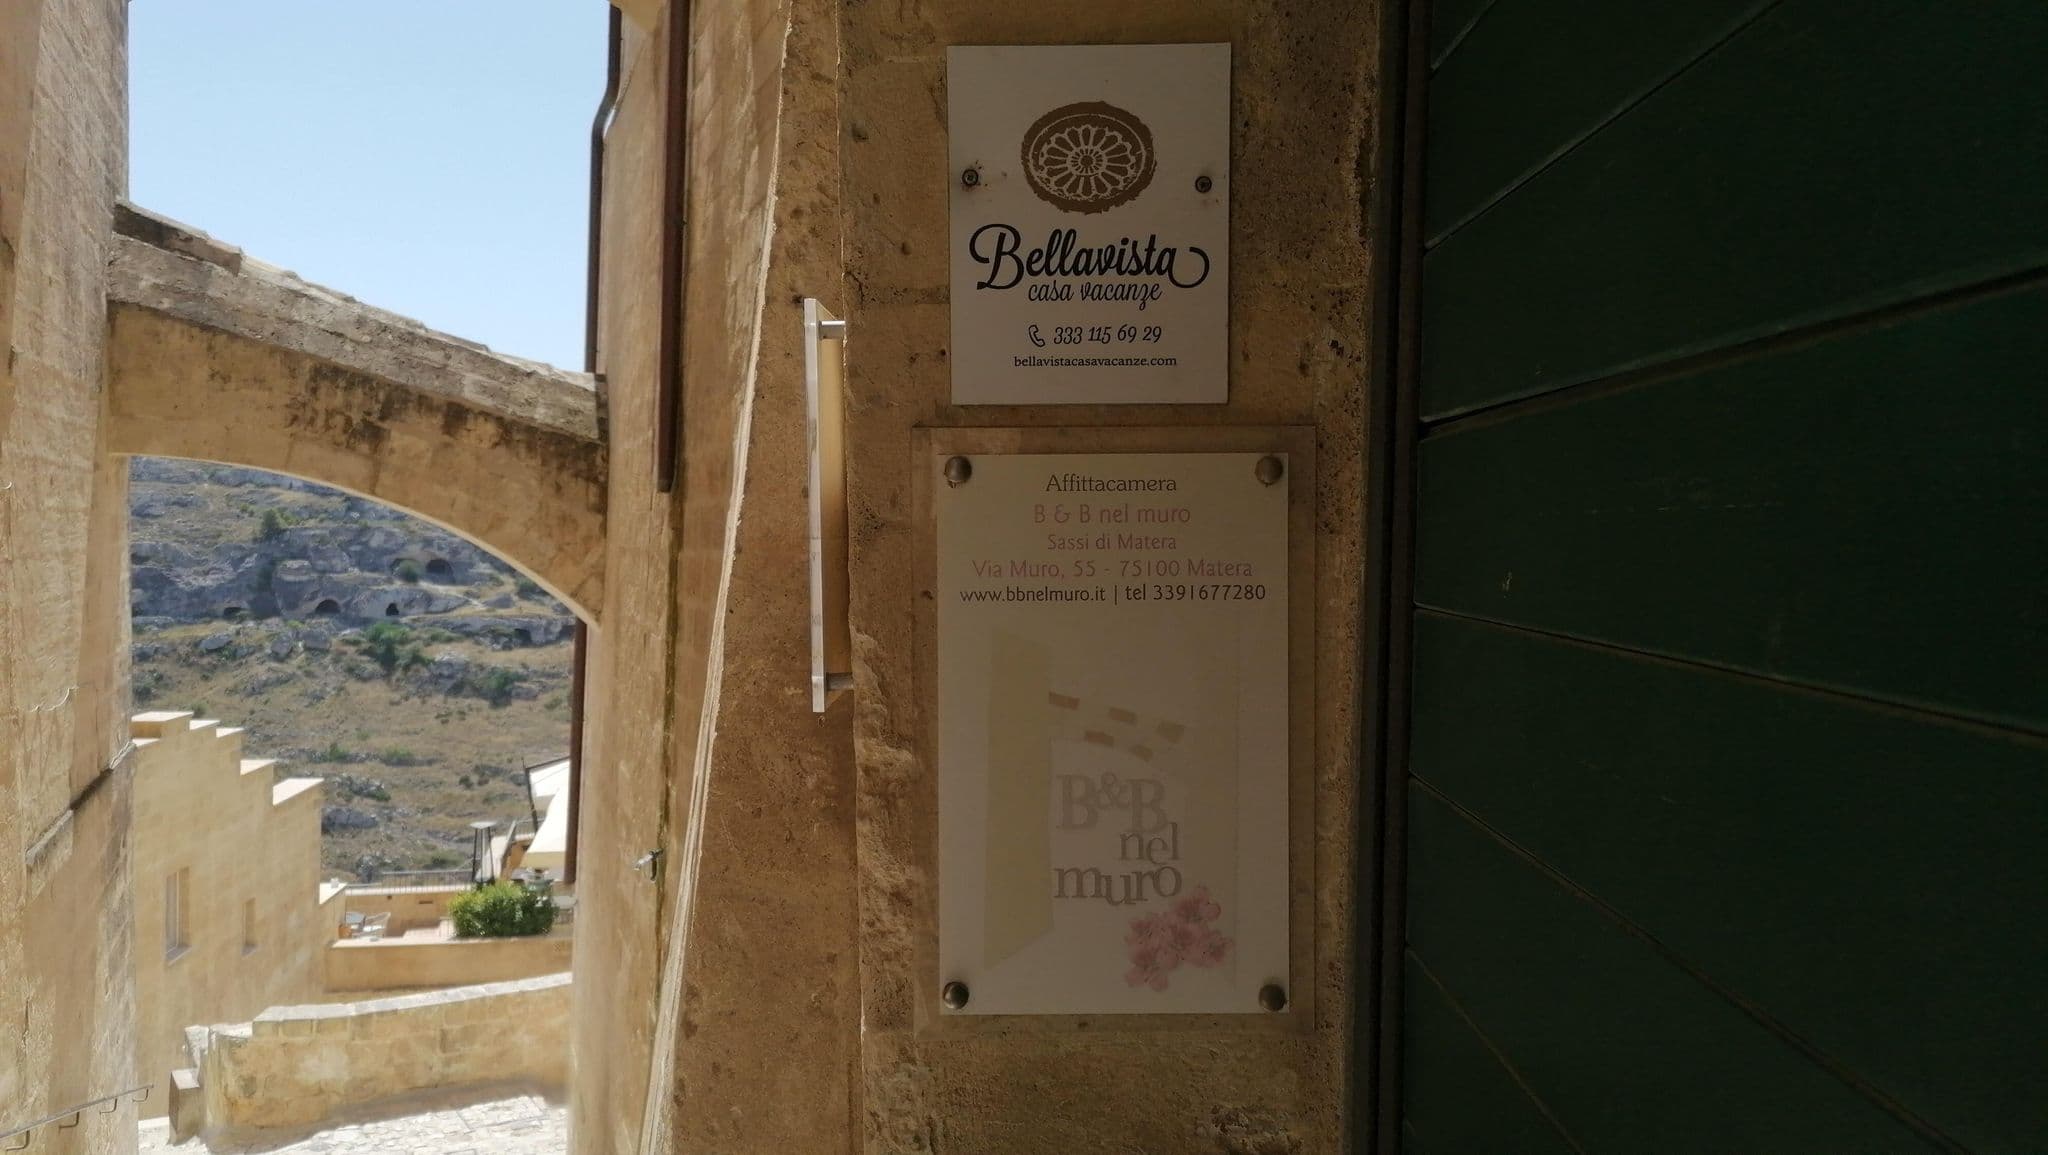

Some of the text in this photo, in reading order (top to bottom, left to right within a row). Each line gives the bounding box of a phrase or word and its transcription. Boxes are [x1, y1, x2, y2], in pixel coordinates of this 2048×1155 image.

[969, 224, 1210, 290] Bellavista
[1028, 280, 1163, 310] casa vacanze
[1053, 324, 1162, 345] 333 115 69 29
[1014, 356, 1177, 367] bellavistacasavacanze.com
[1046, 473, 1177, 492] Affittacamera
[1034, 503, 1191, 523] B & B nel muro
[1047, 534, 1177, 550] Sassi di Matera
[972, 560, 1002, 577] Via
[1010, 559, 1065, 580] Muro,
[1073, 559, 1096, 577] 55
[1119, 559, 1179, 577] 75100
[1187, 558, 1253, 577] Matera
[959, 587, 1105, 602] www.bbnelmuro.it
[1125, 584, 1147, 601] tel
[1153, 584, 1266, 601] 3391677280
[1056, 772, 1169, 833] B&B
[1119, 821, 1180, 865] nel
[1054, 866, 1182, 906] muro
